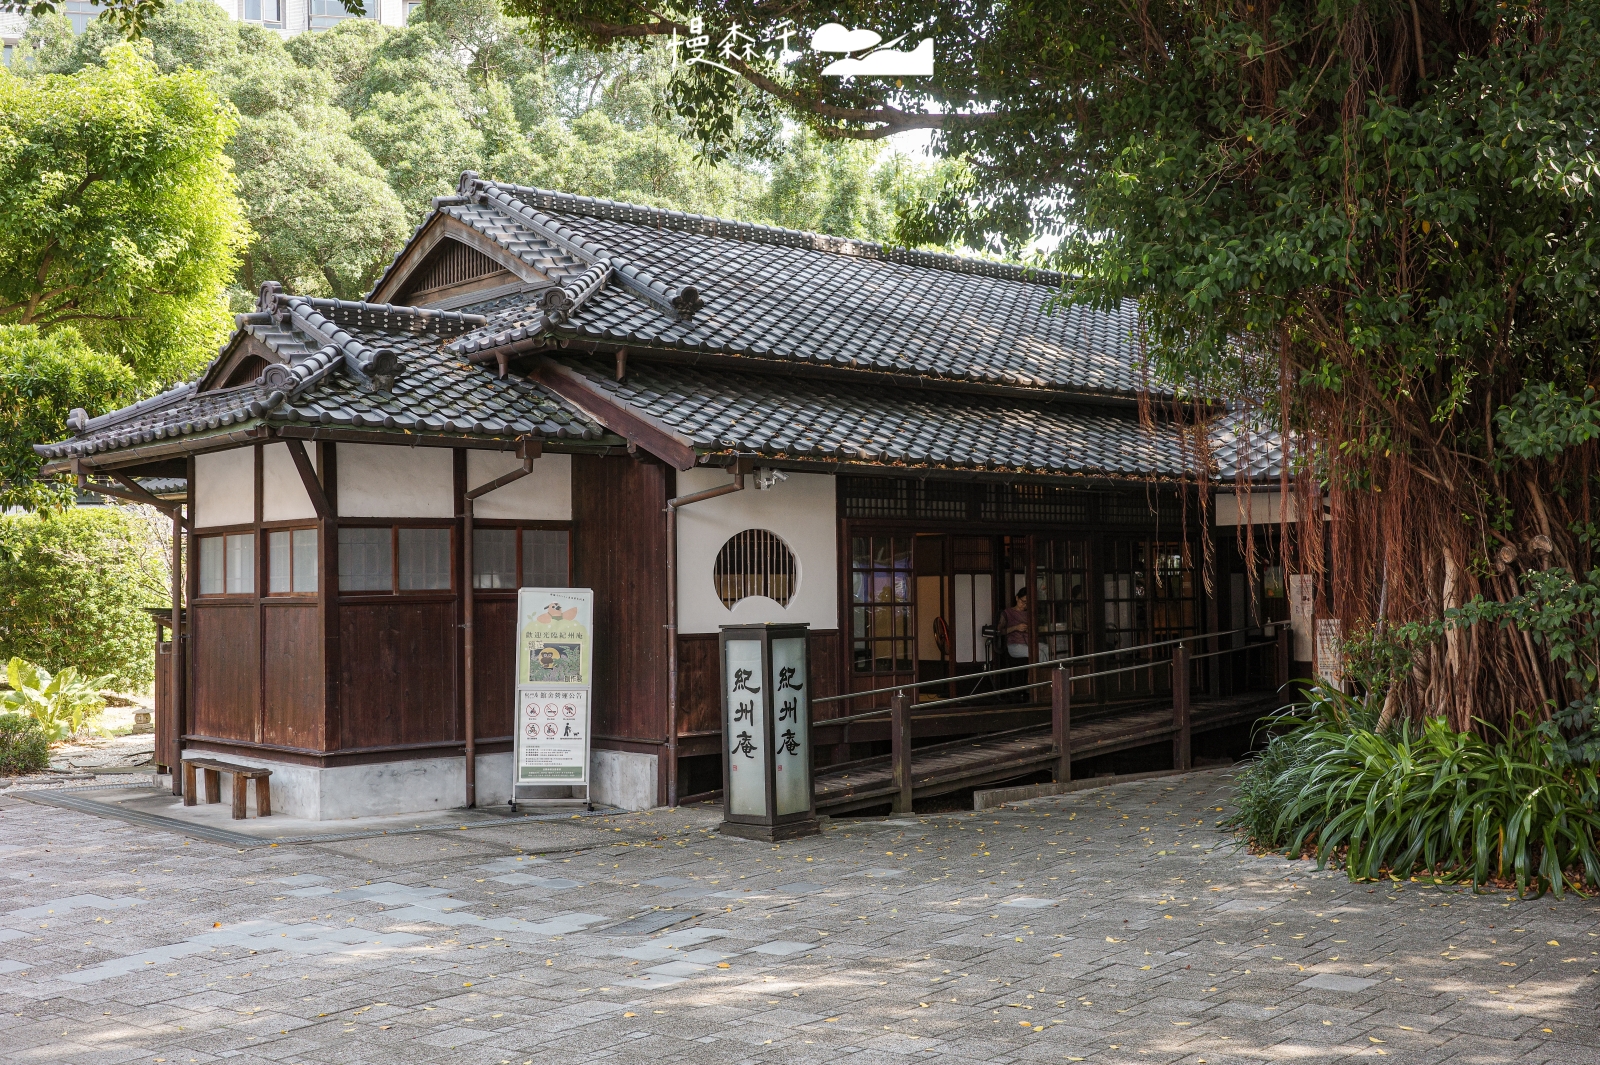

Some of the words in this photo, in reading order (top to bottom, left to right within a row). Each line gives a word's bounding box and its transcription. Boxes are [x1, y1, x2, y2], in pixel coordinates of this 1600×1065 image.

[732, 668, 761, 759] 紀州庵
[777, 666, 804, 756] 紀州庵
